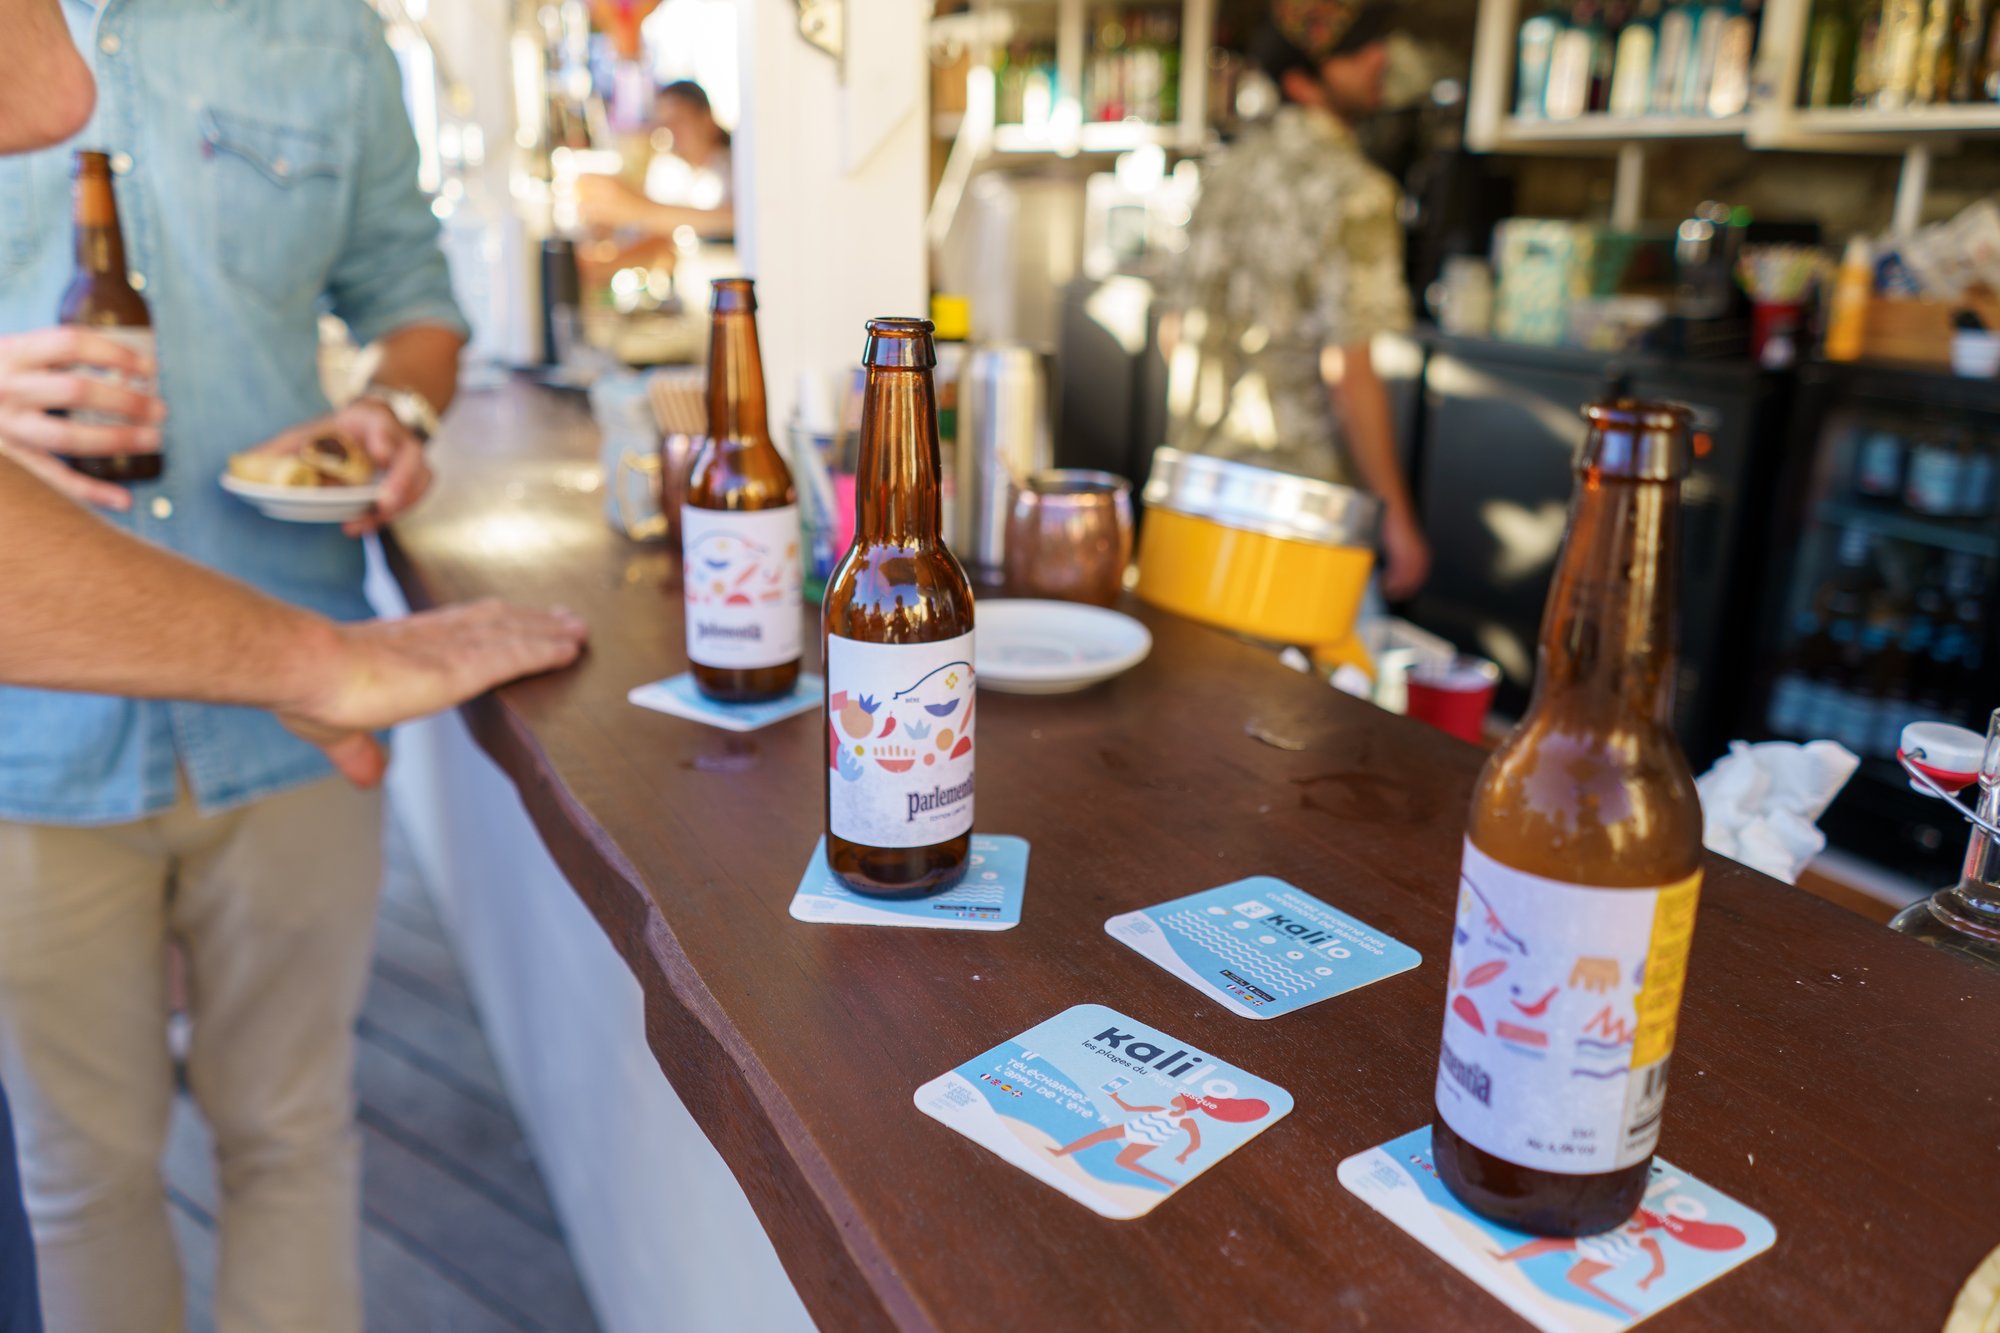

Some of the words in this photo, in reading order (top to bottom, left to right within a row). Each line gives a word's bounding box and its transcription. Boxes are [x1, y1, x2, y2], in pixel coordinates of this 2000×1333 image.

[1266, 914, 1351, 959] kalilo
[1081, 1039, 1097, 1051] les
[1096, 1048, 1131, 1068] plages
[1132, 1064, 1148, 1076] du
[1176, 1086, 1218, 1111] Basque
[1093, 1026, 1239, 1099] kalilo
